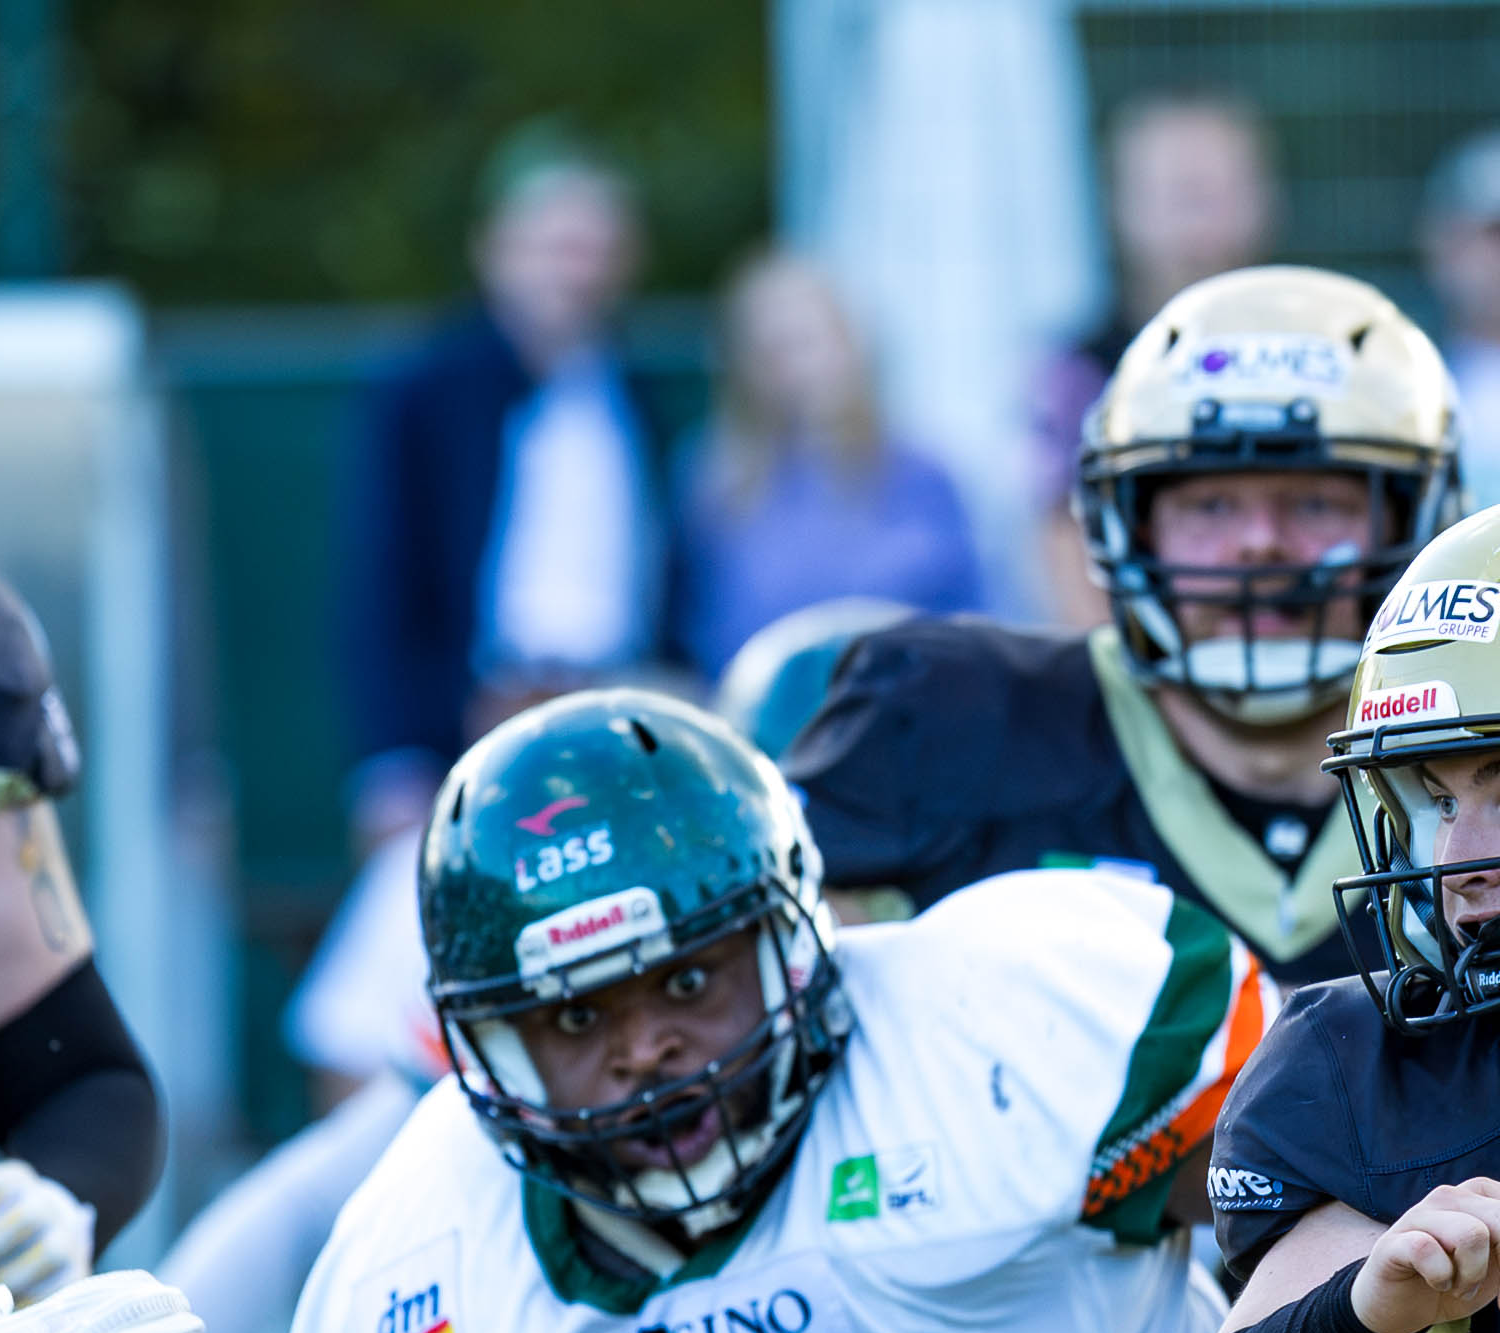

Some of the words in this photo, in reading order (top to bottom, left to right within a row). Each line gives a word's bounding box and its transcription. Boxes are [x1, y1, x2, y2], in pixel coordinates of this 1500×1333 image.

[1438, 622, 1490, 640] GRUPPE
[1361, 688, 1437, 722] Riddell
[548, 905, 624, 945] Riddell
